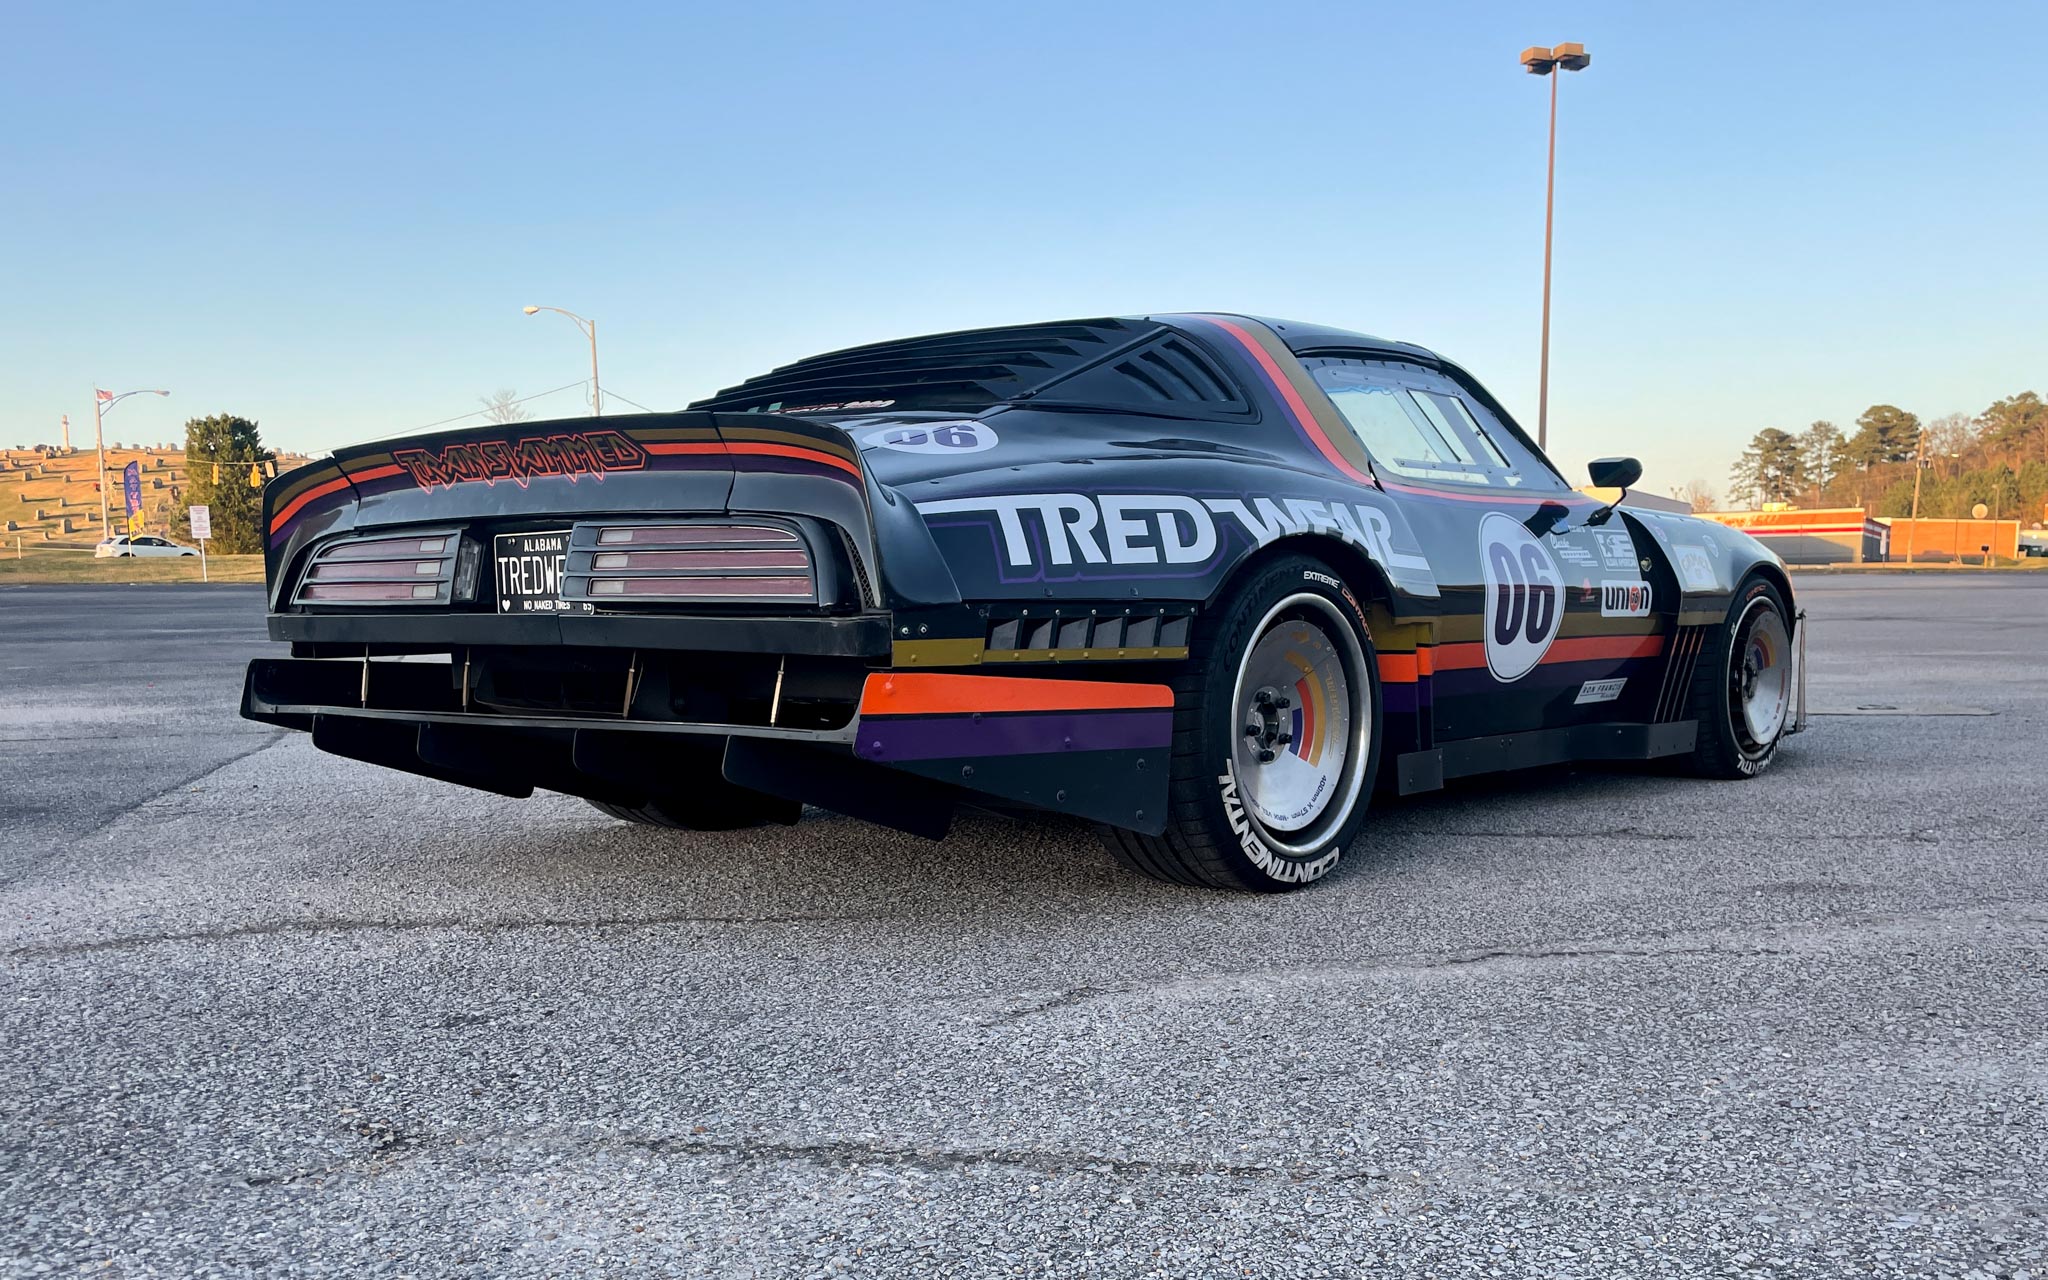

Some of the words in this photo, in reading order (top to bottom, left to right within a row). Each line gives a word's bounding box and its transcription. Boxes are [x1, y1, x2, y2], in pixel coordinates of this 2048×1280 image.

[884, 425, 979, 448] 06
[917, 494, 1217, 566] TRED
[524, 538, 562, 552] ALABAMA
[1304, 571, 1340, 589] EXTREME
[1489, 542, 1555, 645] 06
[1341, 587, 1374, 642] CONTACT
[1582, 686, 1596, 694] RON
[1311, 774, 1327, 803] 400mm
[1218, 758, 1341, 884] CONTINENTAL
